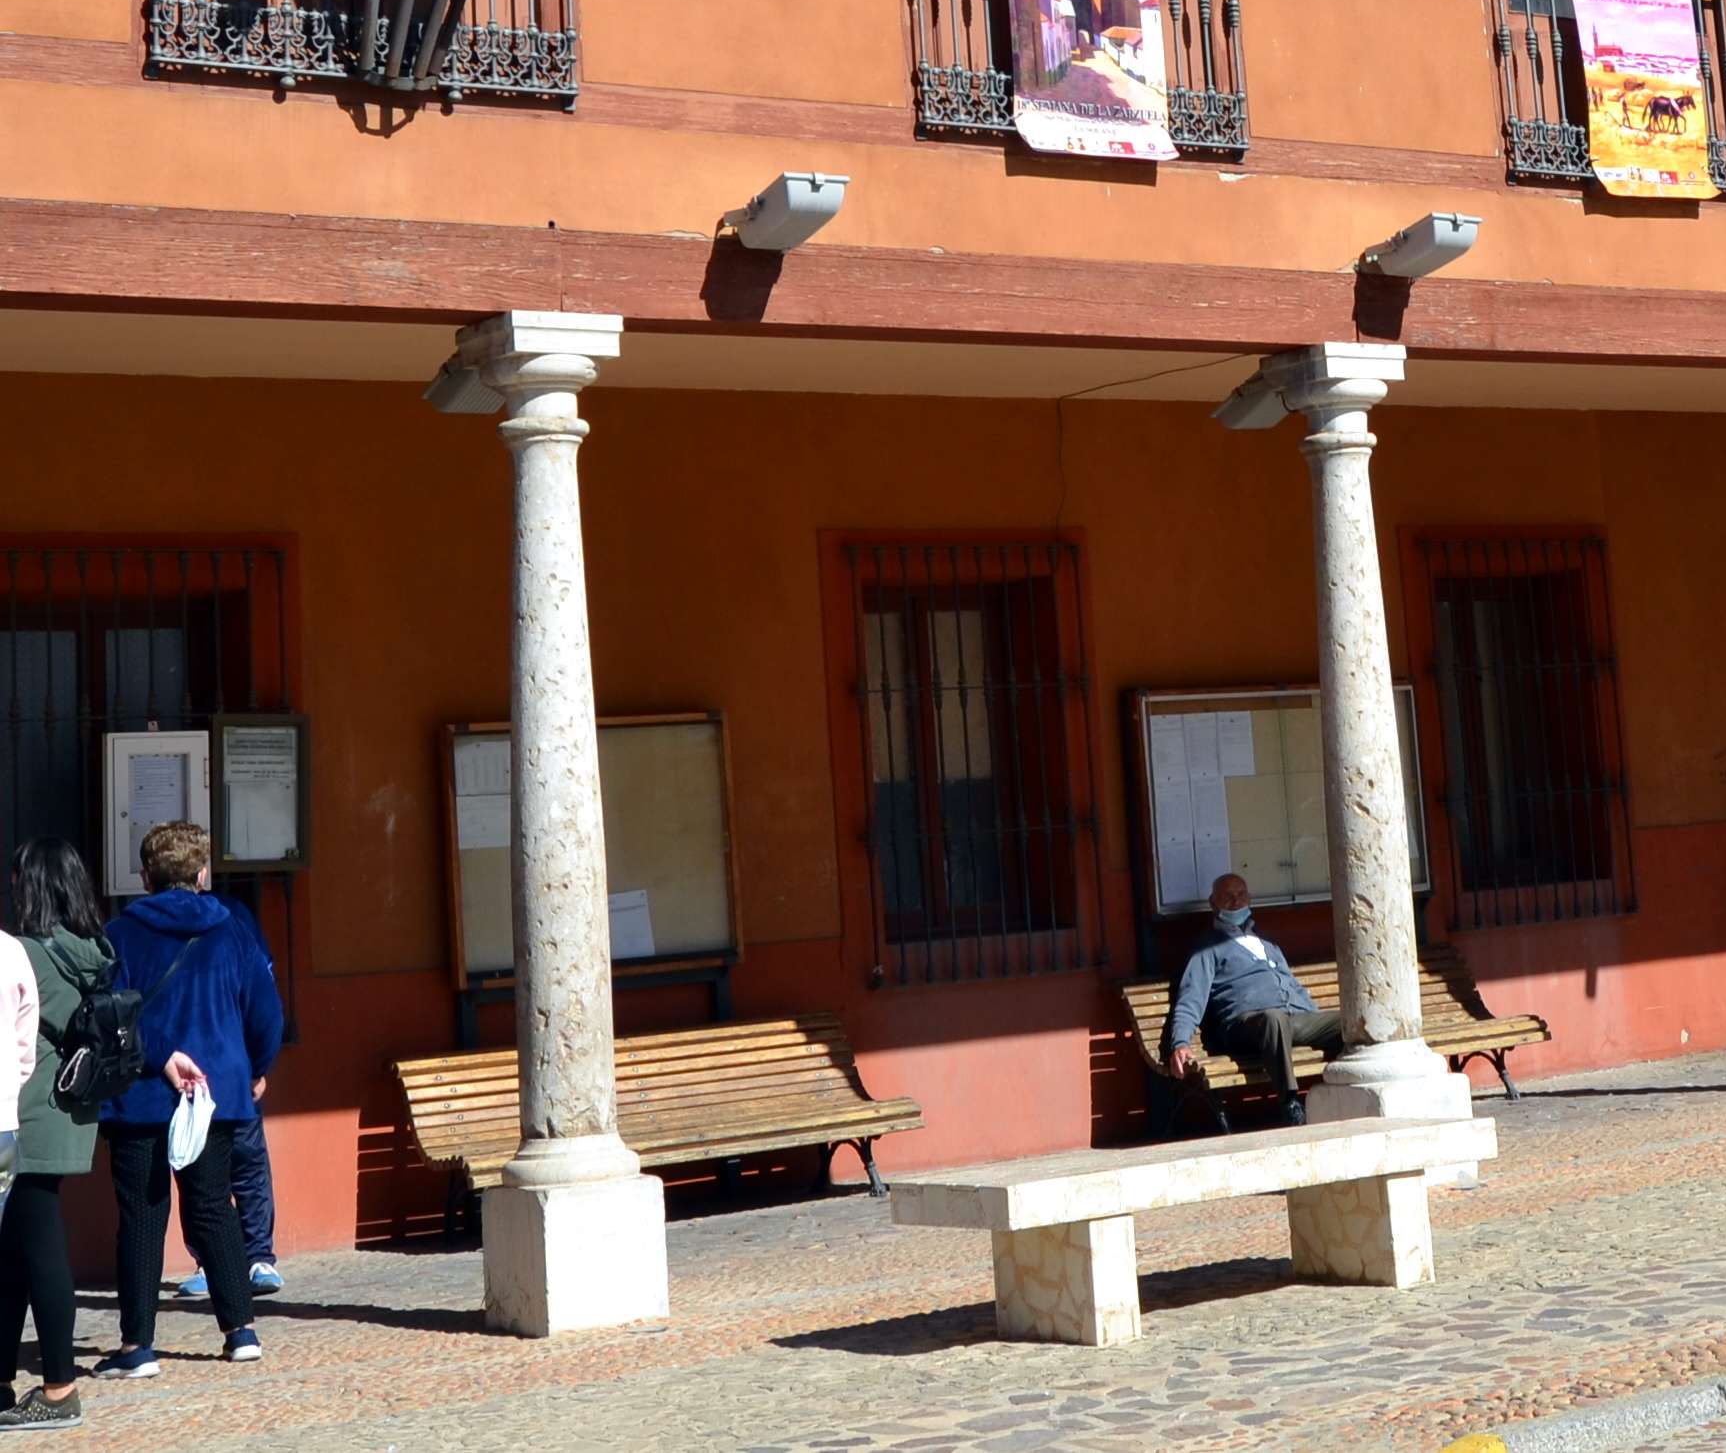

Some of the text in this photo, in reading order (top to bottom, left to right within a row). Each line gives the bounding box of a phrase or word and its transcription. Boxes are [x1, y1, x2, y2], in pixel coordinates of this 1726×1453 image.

[1032, 99, 1078, 114] SEMANA
[1080, 102, 1095, 115] DE
[1098, 104, 1111, 116] LA
[1112, 105, 1167, 122] ZARZUELA
